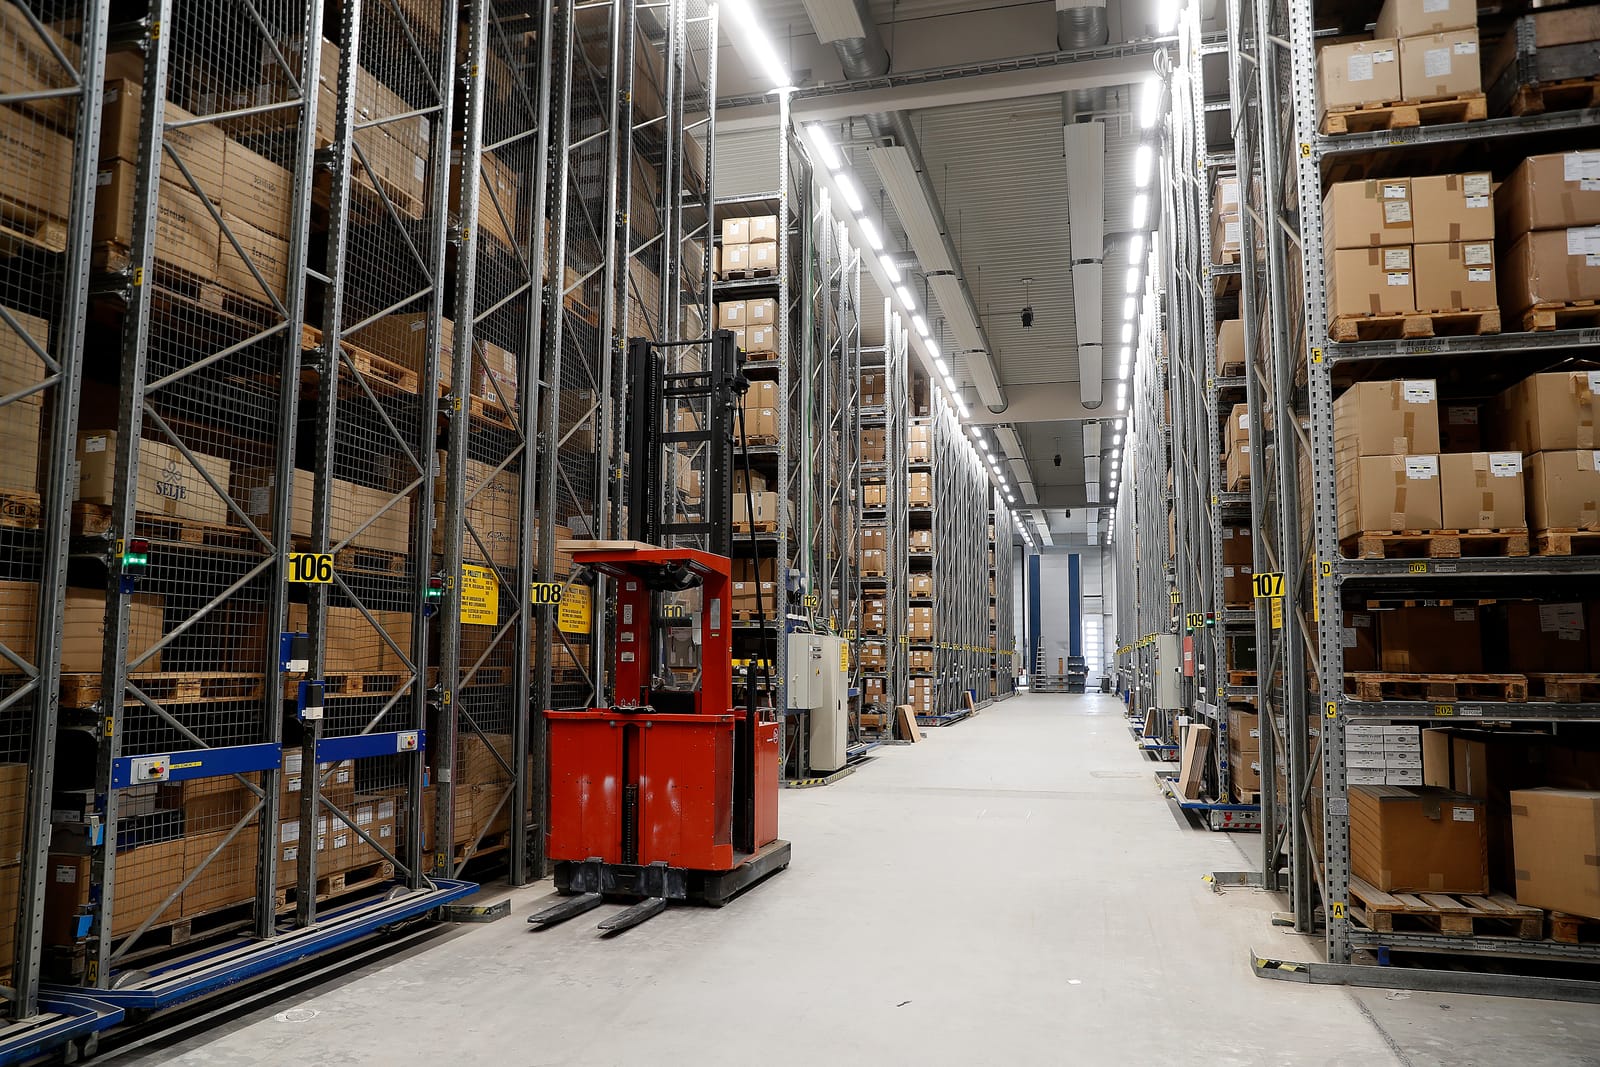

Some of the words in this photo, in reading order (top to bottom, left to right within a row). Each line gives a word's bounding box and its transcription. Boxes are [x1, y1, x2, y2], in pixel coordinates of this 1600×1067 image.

[1302, 145, 1309, 156] G
[136, 270, 142, 283] F
[1313, 350, 1320, 361] F
[155, 480, 188, 501] SELJE
[8, 505, 26, 516] EUR
[289, 553, 332, 582] 106
[1323, 563, 1330, 574] D
[1253, 573, 1285, 597] 107
[532, 584, 562, 603] 108
[804, 595, 817, 606] 112
[1187, 613, 1204, 628] 109
[844, 629, 856, 639] 114
[1327, 704, 1334, 715] C
[1334, 904, 1342, 916] A
